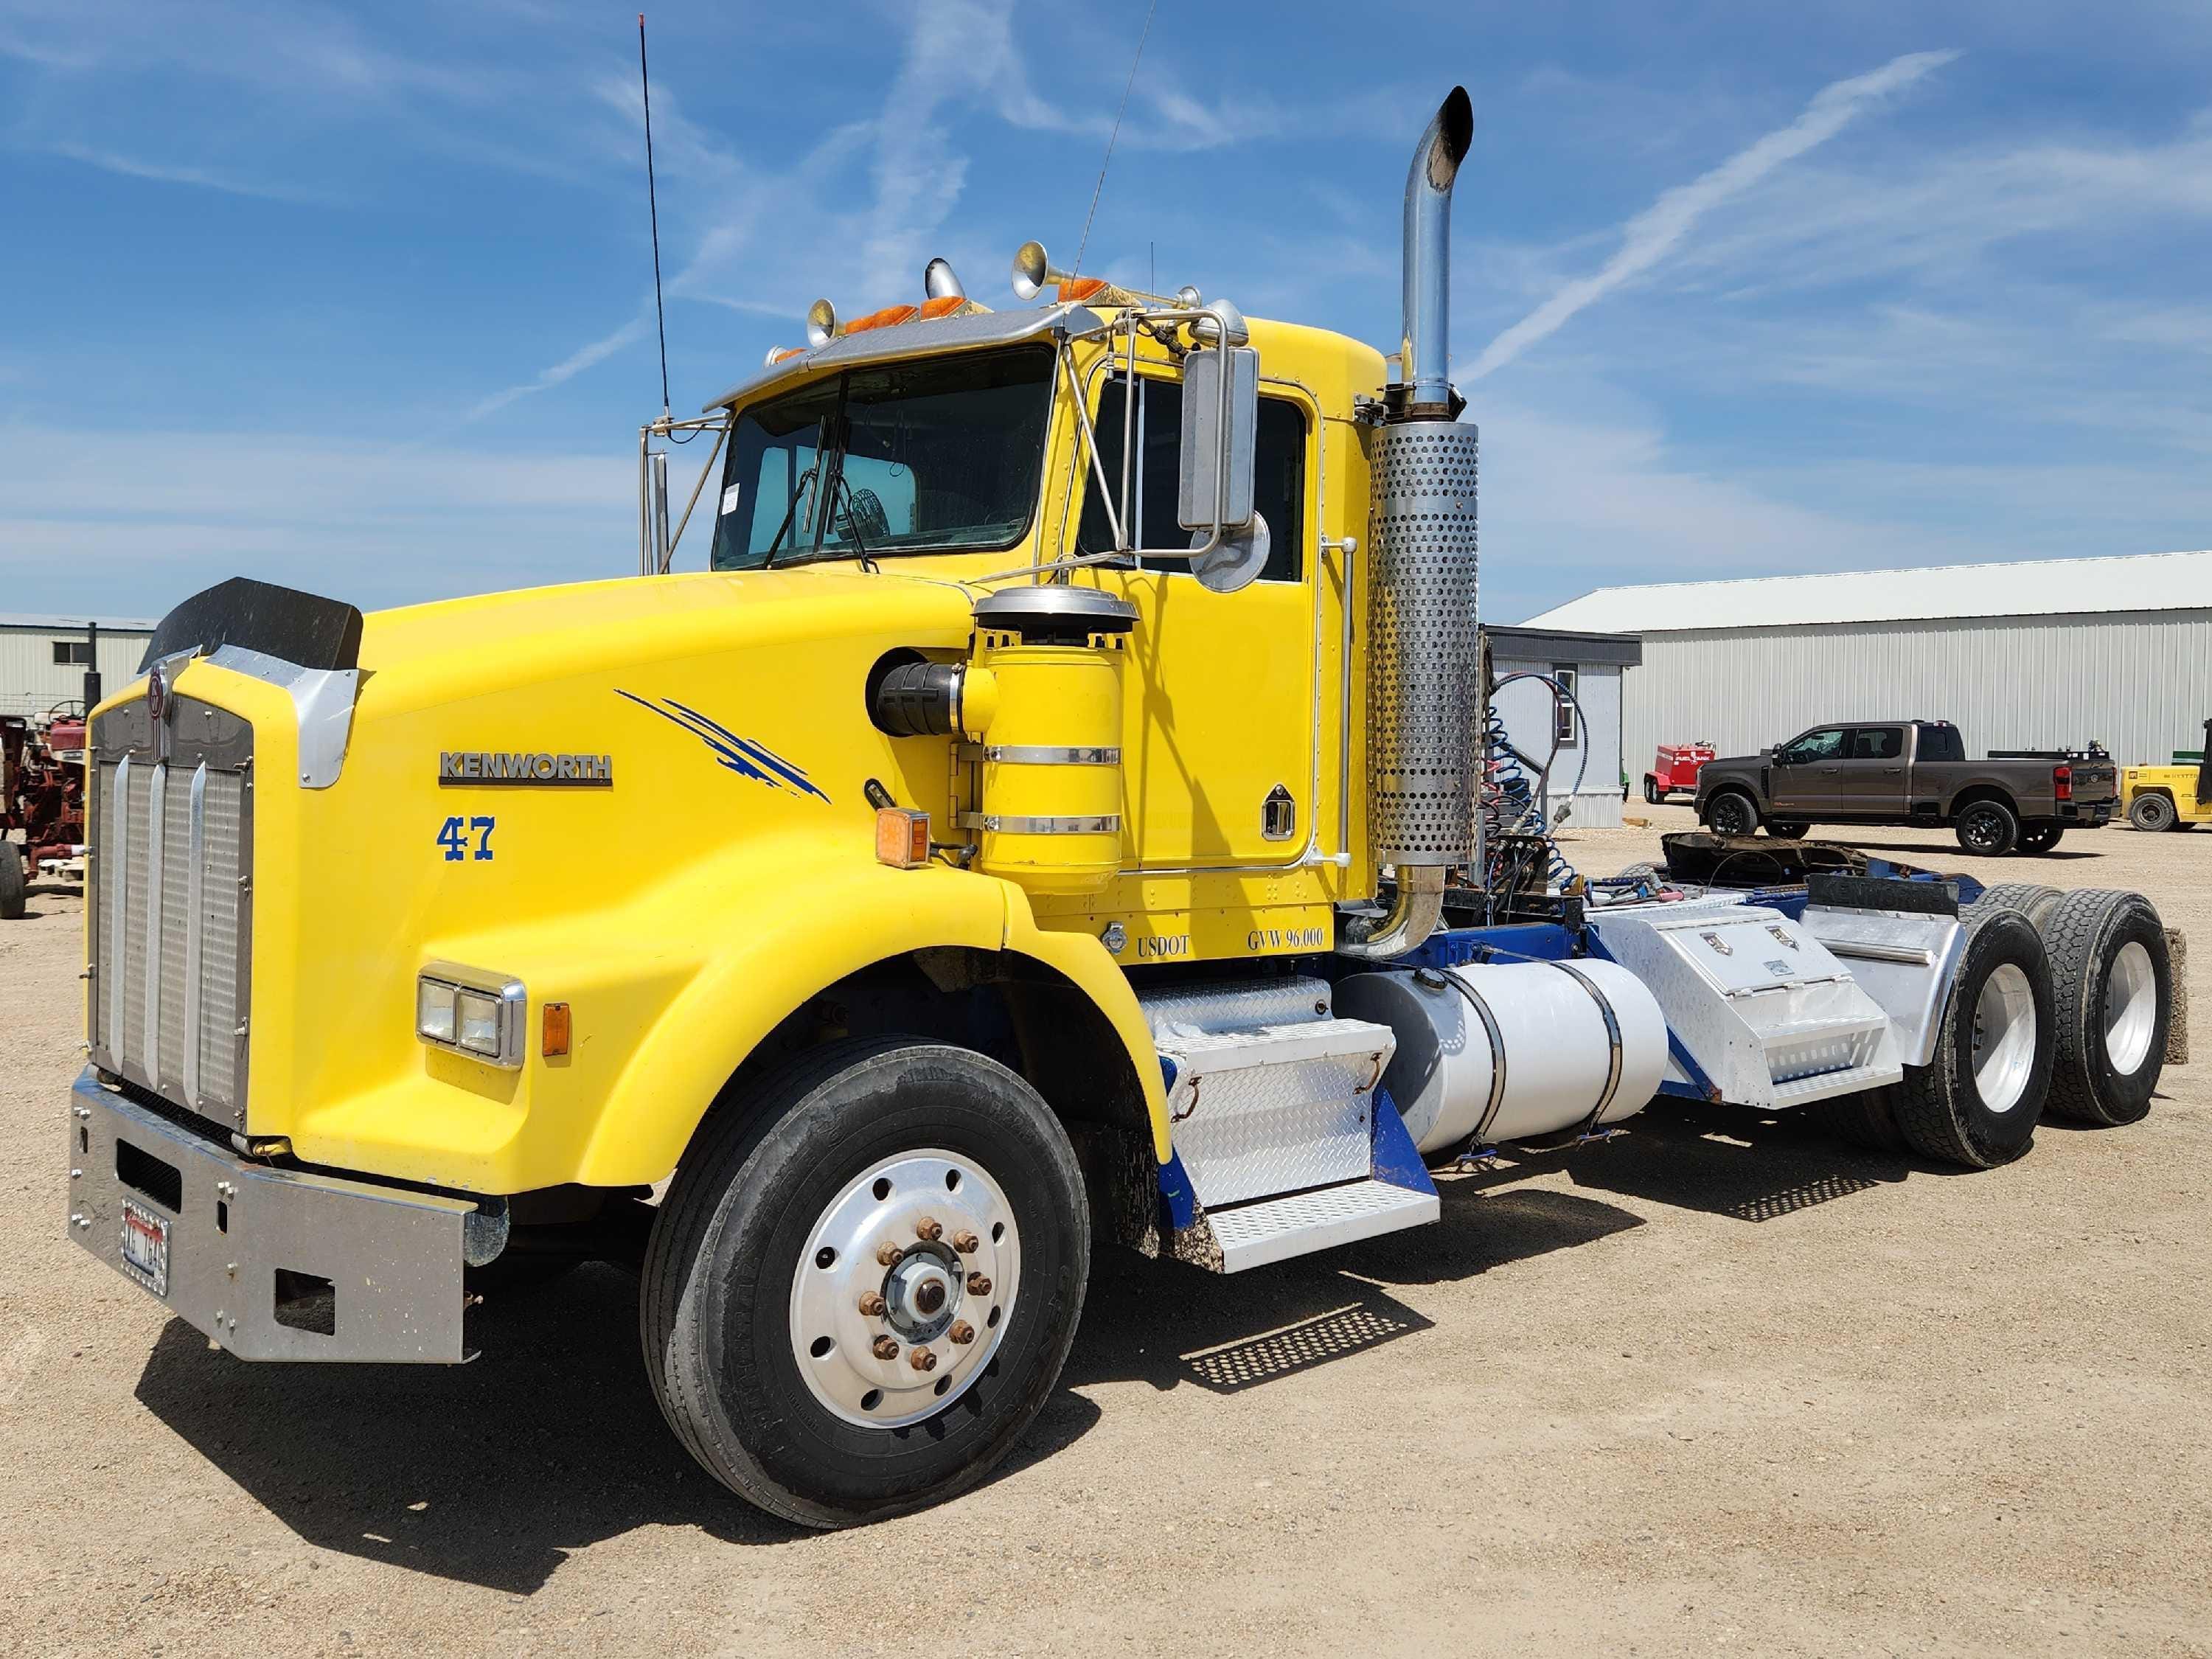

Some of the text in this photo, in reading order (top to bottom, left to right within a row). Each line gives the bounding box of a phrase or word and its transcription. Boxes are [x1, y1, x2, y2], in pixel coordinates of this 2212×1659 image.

[440, 751, 613, 780] KENWORTH
[436, 816, 495, 861] 47
[1137, 935, 1190, 957] USDOT
[1248, 927, 1324, 950] GVW 96,000
